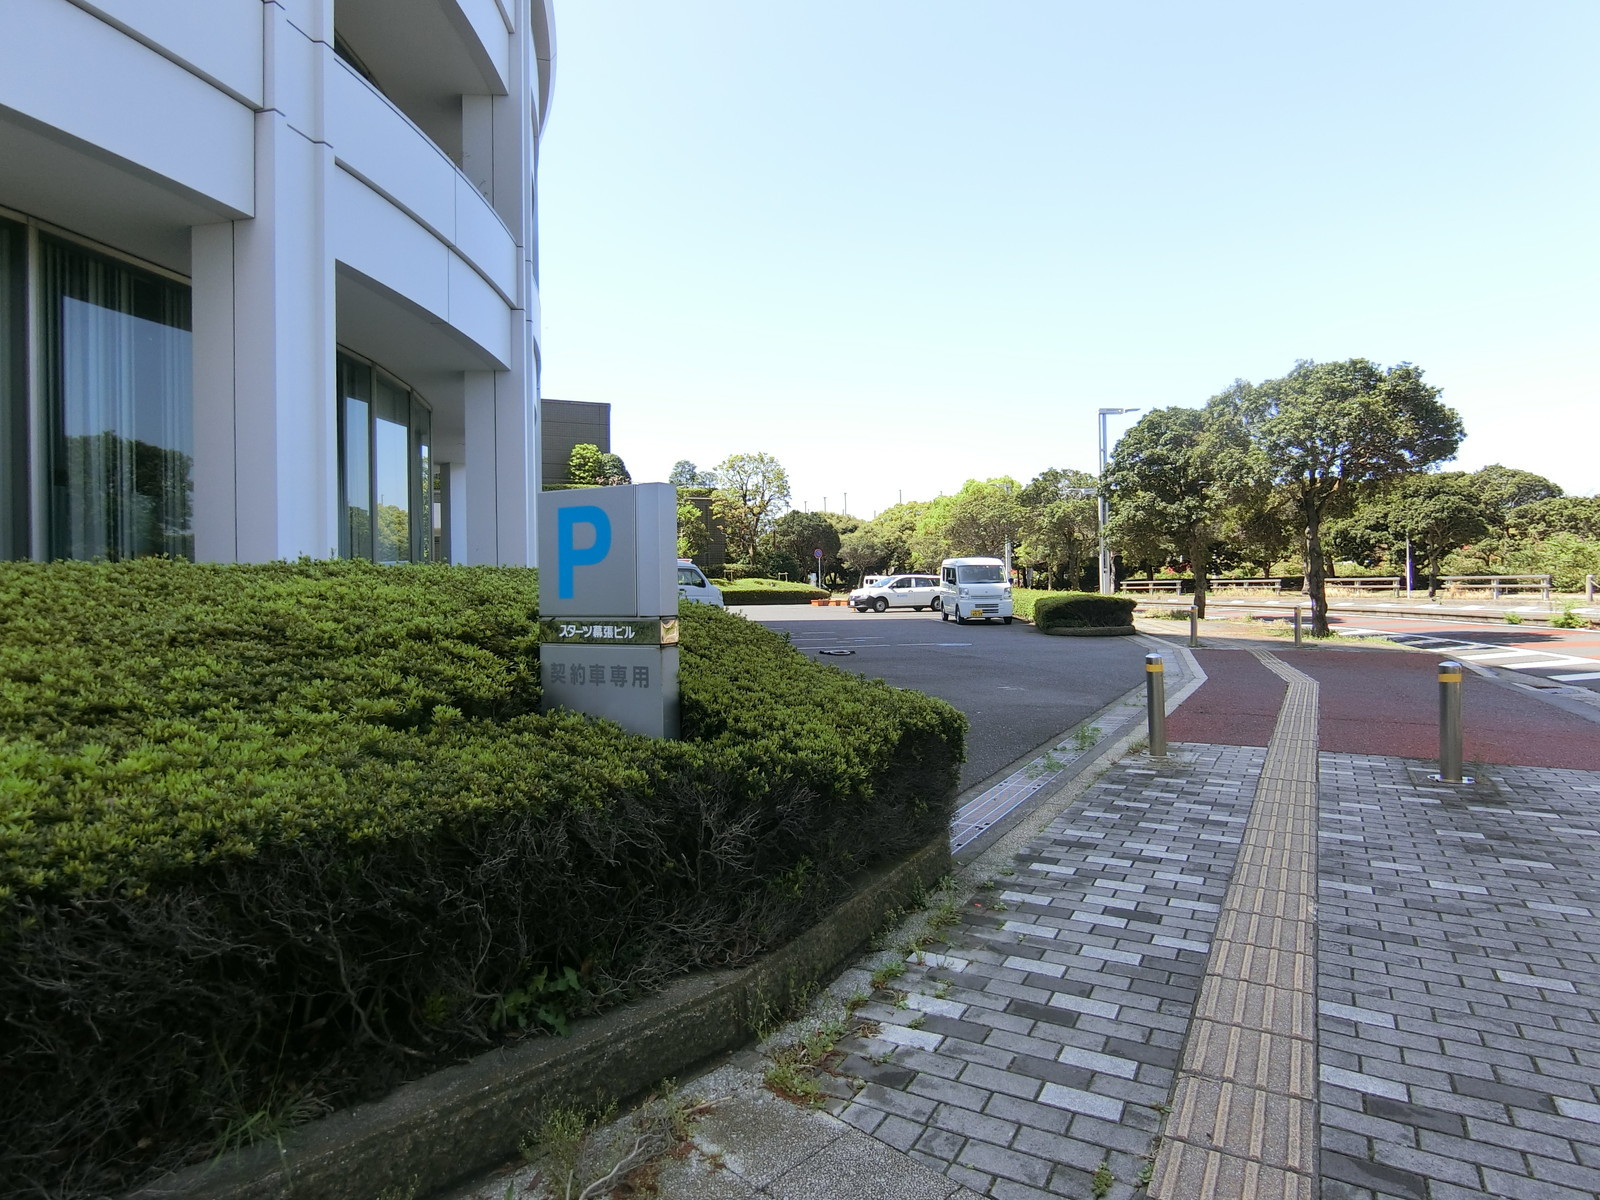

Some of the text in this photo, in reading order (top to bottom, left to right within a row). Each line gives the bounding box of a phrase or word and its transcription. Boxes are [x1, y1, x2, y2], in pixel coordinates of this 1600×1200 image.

[558, 506, 612, 599] P
[559, 625, 636, 639] スターツ幕張ビル
[551, 662, 650, 688] 契約車専用
